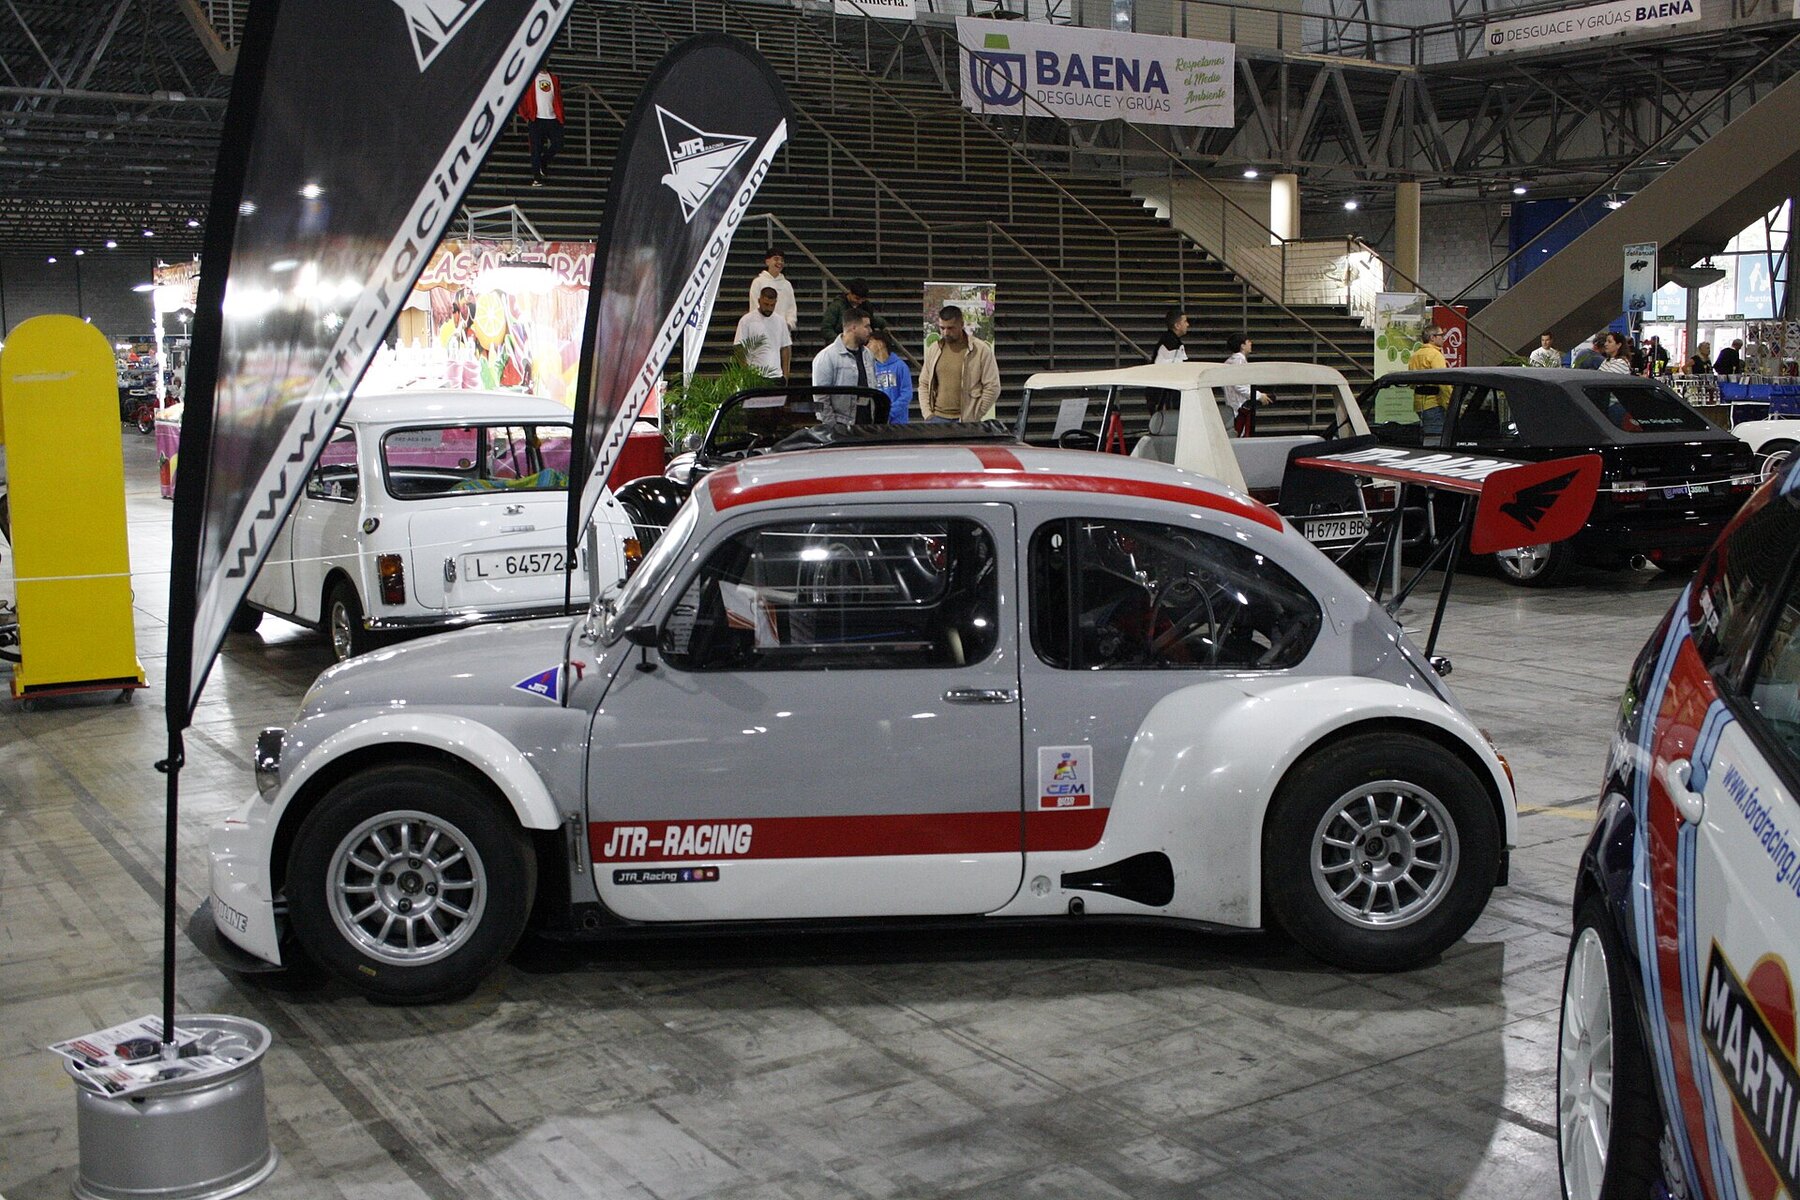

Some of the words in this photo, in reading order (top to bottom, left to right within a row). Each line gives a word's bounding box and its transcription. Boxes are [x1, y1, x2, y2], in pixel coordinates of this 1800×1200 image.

[1507, 21, 1573, 42] DESGUACE
[1576, 19, 1584, 29] Y
[1588, 11, 1631, 28] GRÚAS
[1635, 0, 1693, 22] BAENA
[1035, 50, 1169, 94] BAENA
[1194, 72, 1220, 86] Medio
[1037, 90, 1112, 108] DESGUACE
[1115, 95, 1124, 107] Y
[1125, 94, 1171, 112] GRÚAS
[1184, 88, 1225, 105] Ambiente
[226, 0, 562, 578] www.jtr-racing.co
[595, 158, 770, 476] www.jtr-racing.com
[1307, 524, 1314, 539] H
[1317, 522, 1346, 538] 6778
[477, 559, 489, 577] L
[506, 552, 565, 575] 64572
[1046, 783, 1085, 795] CEM
[604, 824, 753, 857] JTR-RACING
